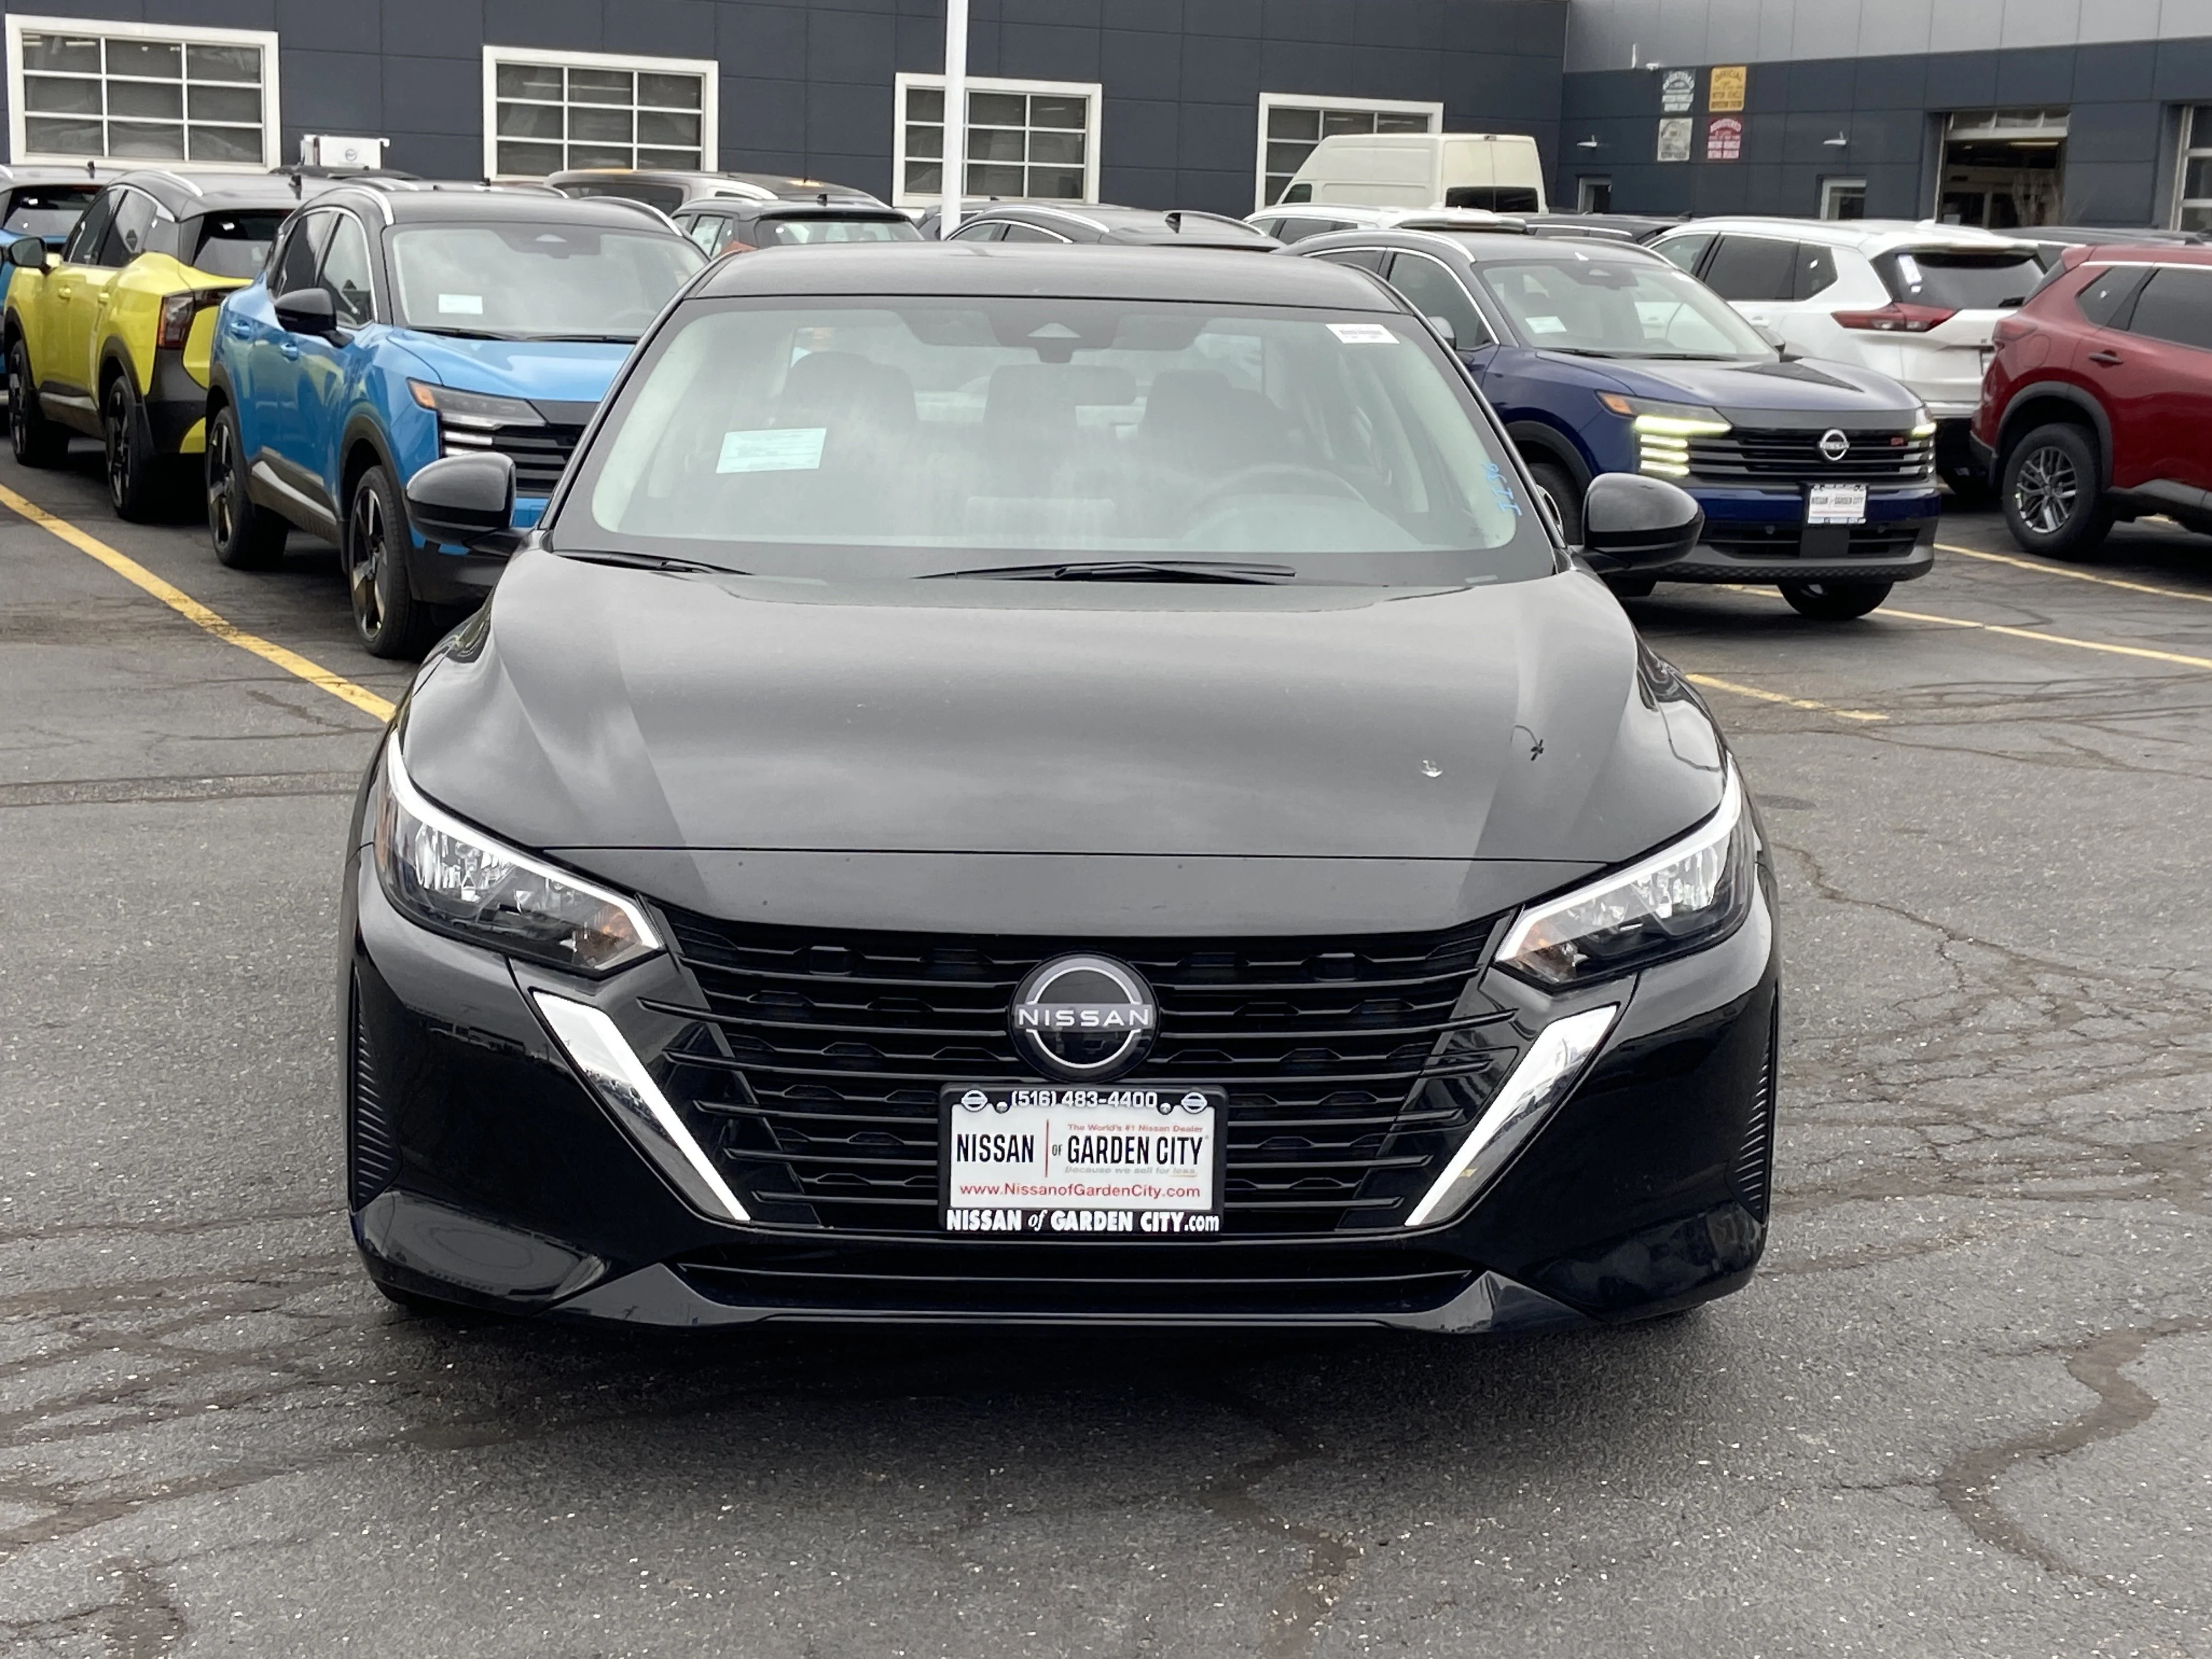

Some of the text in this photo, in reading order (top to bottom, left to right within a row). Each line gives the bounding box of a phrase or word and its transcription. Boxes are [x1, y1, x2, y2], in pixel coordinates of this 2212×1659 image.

[1019, 1009, 1149, 1027] NISSAN
[1012, 1091, 1158, 1108] (516) 483-4400
[957, 1134, 1034, 1163] NISSAN
[1068, 1135, 1149, 1164] GARDEN
[1156, 1136, 1203, 1165] CITY
[960, 1183, 1200, 1199] www.NissanofGardenCity.com
[947, 1209, 1220, 1232] NISSAN of GARDEN CITY.com
